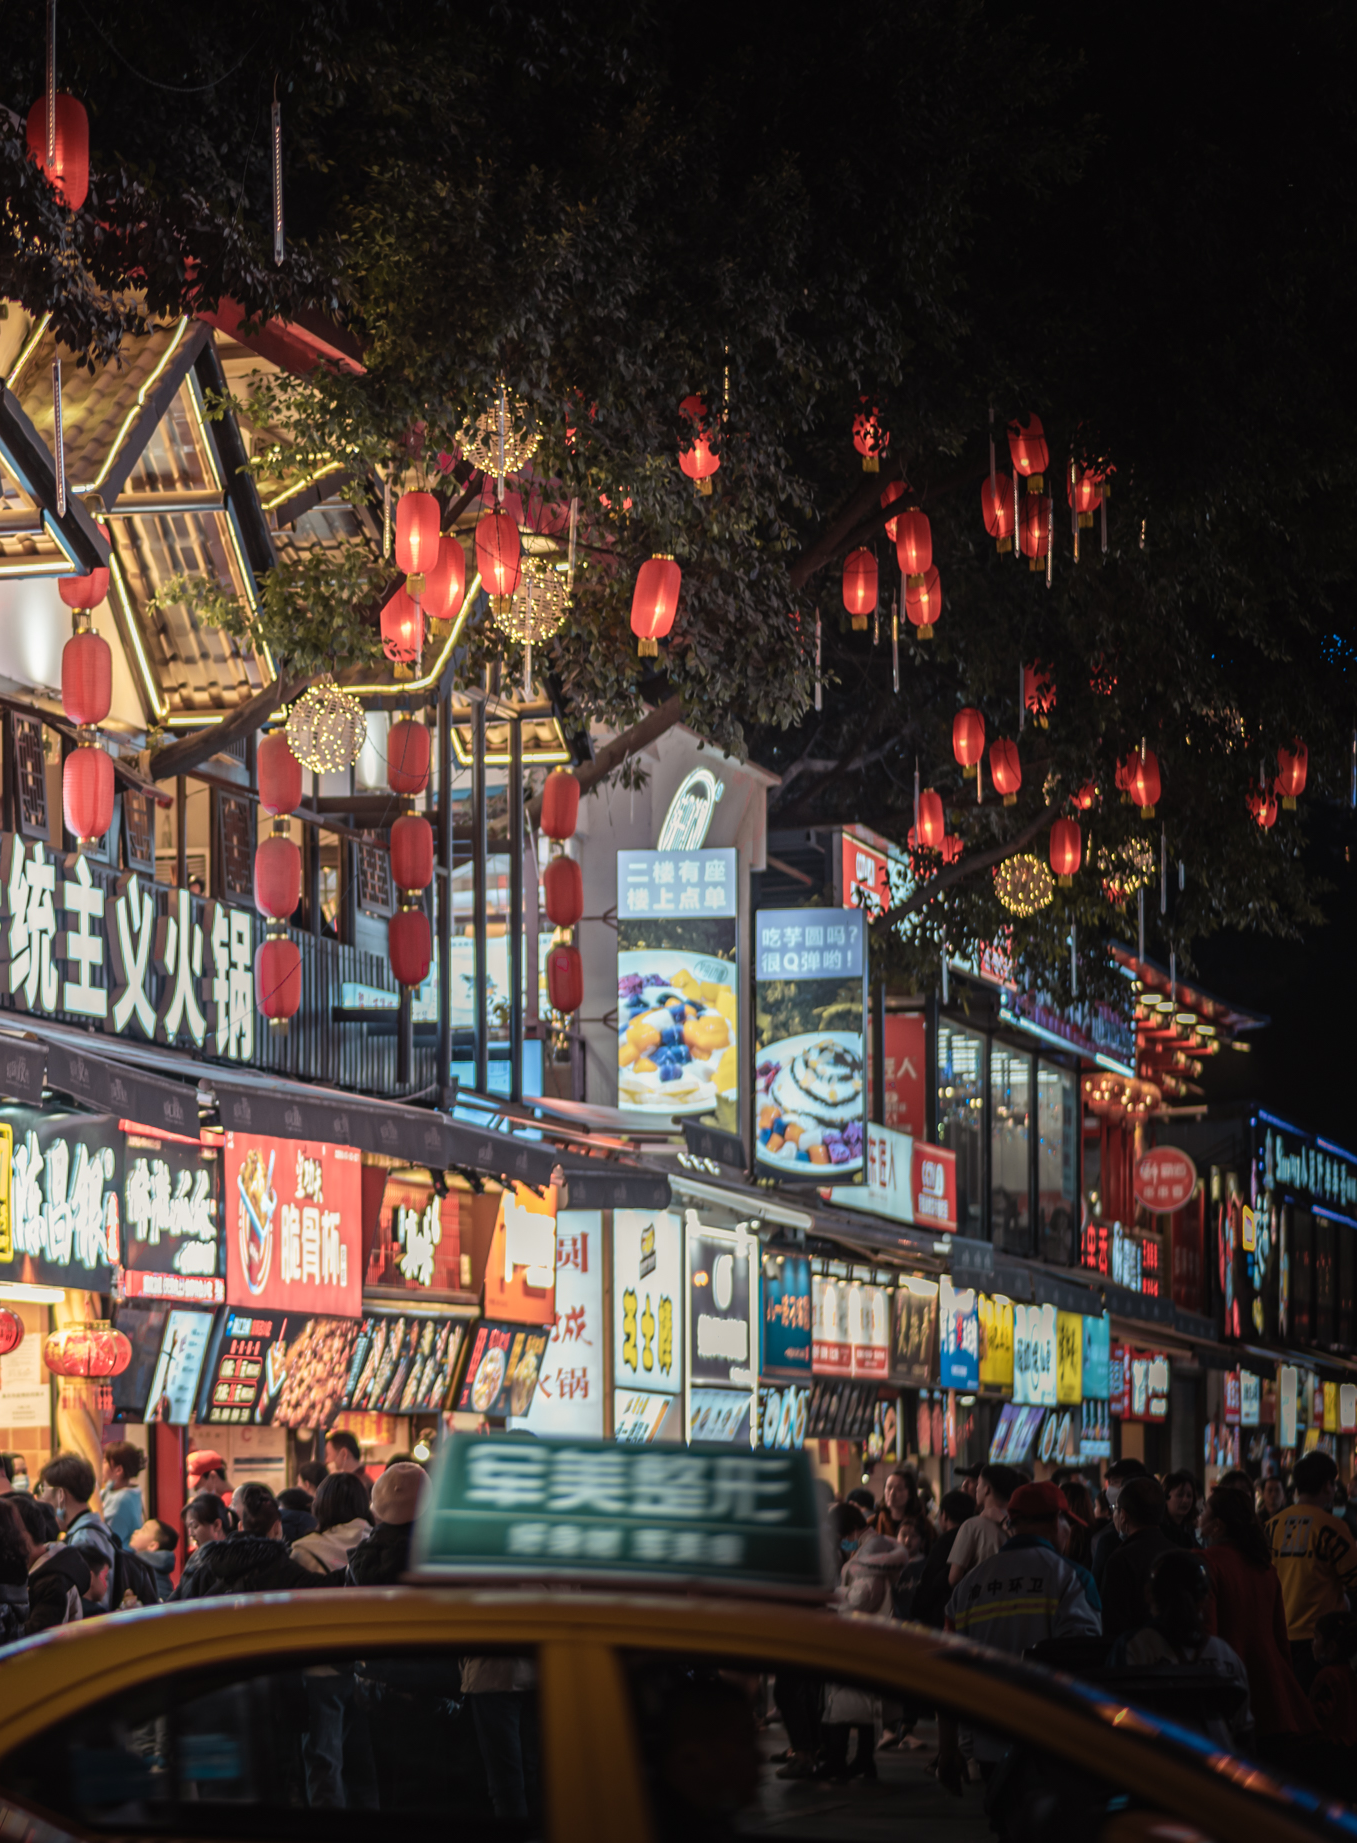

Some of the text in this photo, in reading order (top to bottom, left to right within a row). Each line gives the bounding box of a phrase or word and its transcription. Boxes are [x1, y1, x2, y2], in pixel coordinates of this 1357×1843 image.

[627, 858, 727, 883] 二楼有座
[627, 886, 727, 911] 楼上点单
[761, 923, 859, 948] 吃芋圆吗？
[761, 950, 853, 974] 很Q弹哟！
[280, 1203, 342, 1288] 脆骨杯
[968, 1576, 1044, 1602] 渝中环卫
